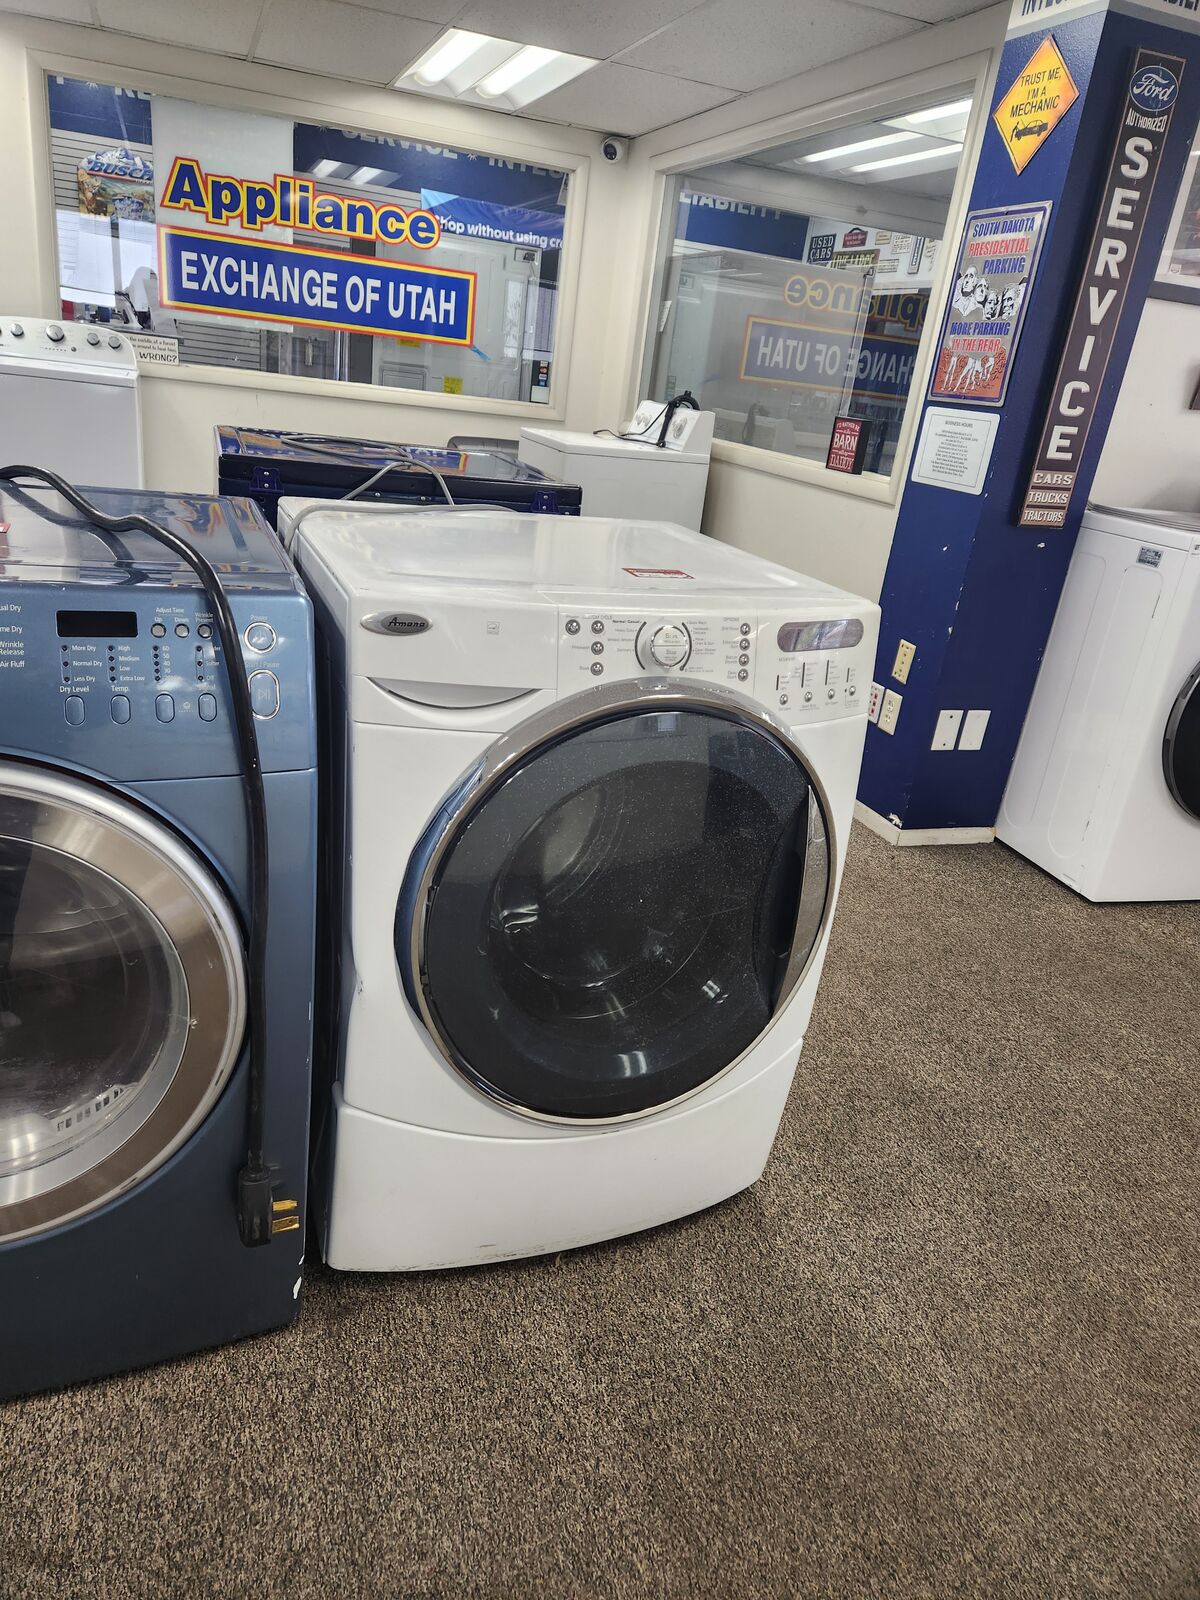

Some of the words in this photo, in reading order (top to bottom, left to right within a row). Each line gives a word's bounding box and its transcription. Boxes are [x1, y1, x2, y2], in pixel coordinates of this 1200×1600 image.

[1020, 70, 1046, 87] TRUST
[1048, 67, 1061, 81] ME,
[1027, 88, 1039, 100] I'M
[1040, 86, 1046, 96] A
[1133, 74, 1175, 101] Ford
[1010, 95, 1060, 118] MECHANIC
[1125, 107, 1168, 132] AUTHORIZED
[163, 159, 440, 248] Appliance
[434, 214, 465, 235] hop
[467, 223, 515, 241] without
[516, 231, 548, 248] using
[972, 220, 1001, 238] SOUTH
[1002, 217, 1036, 234] DAKOTA
[812, 236, 834, 248] USED
[968, 238, 1031, 257] PRESIDENTIAL
[810, 247, 832, 260] CARS
[982, 257, 1026, 275] PARKING
[180, 250, 338, 310] EXCHANGE
[345, 275, 381, 314] OF
[388, 281, 456, 326] UTAH
[1046, 136, 1153, 461] SERVICE
[950, 322, 974, 336] MORE
[973, 322, 1011, 336] PARKING
[952, 338, 962, 350] IN
[962, 338, 978, 350] THE
[980, 338, 1002, 351] REAR
[139, 352, 178, 363] WRONG?
[833, 432, 858, 450] BARN
[1033, 472, 1073, 486] CARS
[1028, 491, 1069, 504] TRUCKS
[1024, 510, 1064, 522] TRACTORS
[10, 604, 22, 613] Dry
[387, 616, 425, 627] Amana
[12, 626, 23, 634] Dry
[10, 660, 25, 668] Fluff
